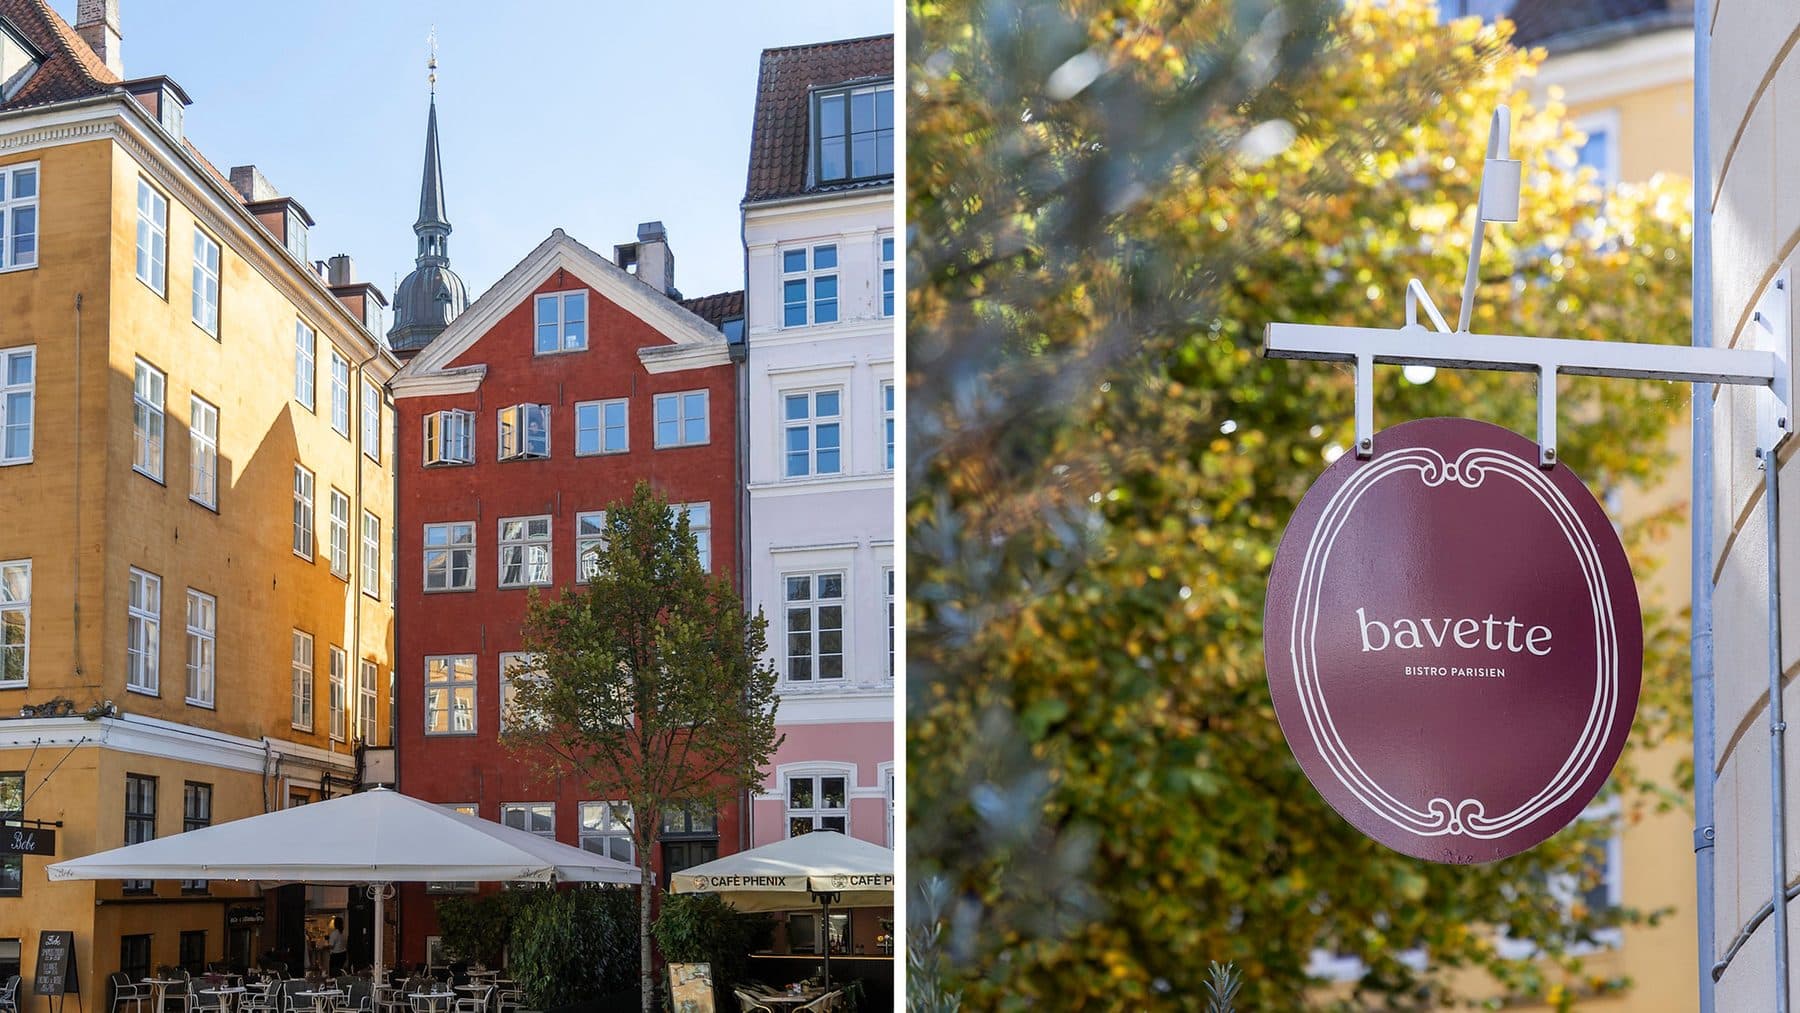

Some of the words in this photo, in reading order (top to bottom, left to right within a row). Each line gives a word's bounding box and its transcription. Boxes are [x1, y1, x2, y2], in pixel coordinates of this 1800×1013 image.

[1356, 607, 1552, 656] bavette
[1405, 666, 1447, 676] BISTRO
[1451, 667, 1505, 677] PARISIEN
[743, 875, 786, 886] PHENIX
